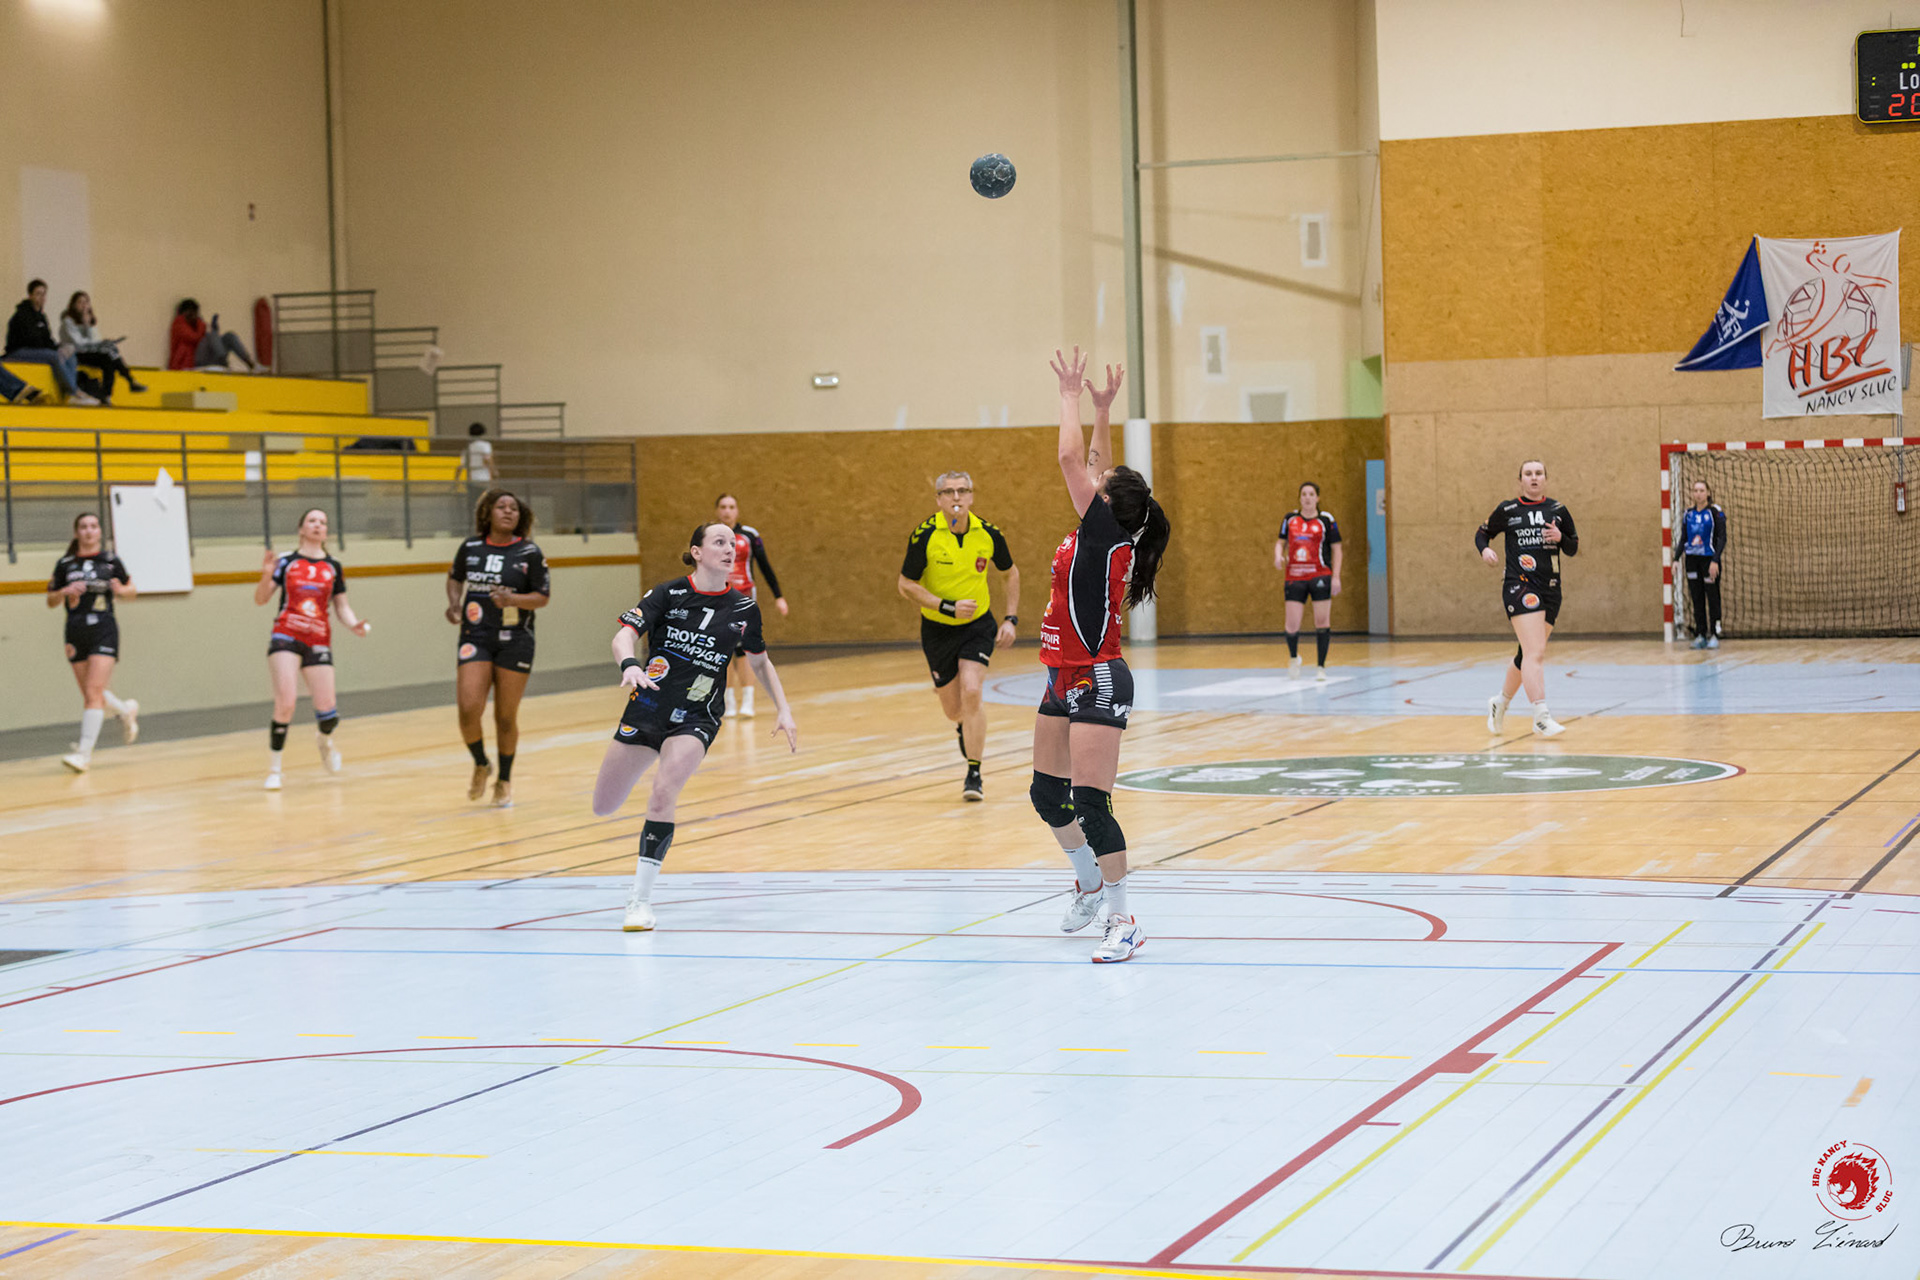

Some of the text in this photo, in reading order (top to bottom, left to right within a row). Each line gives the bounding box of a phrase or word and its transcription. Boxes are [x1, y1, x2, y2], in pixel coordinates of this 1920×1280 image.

[1788, 328, 1887, 390] HBC
[1805, 375, 1897, 414] NANCY SLUC
[1527, 510, 1546, 526] 14
[485, 553, 505, 573] 15
[698, 607, 715, 631] 7
[666, 625, 717, 649] TROYES
